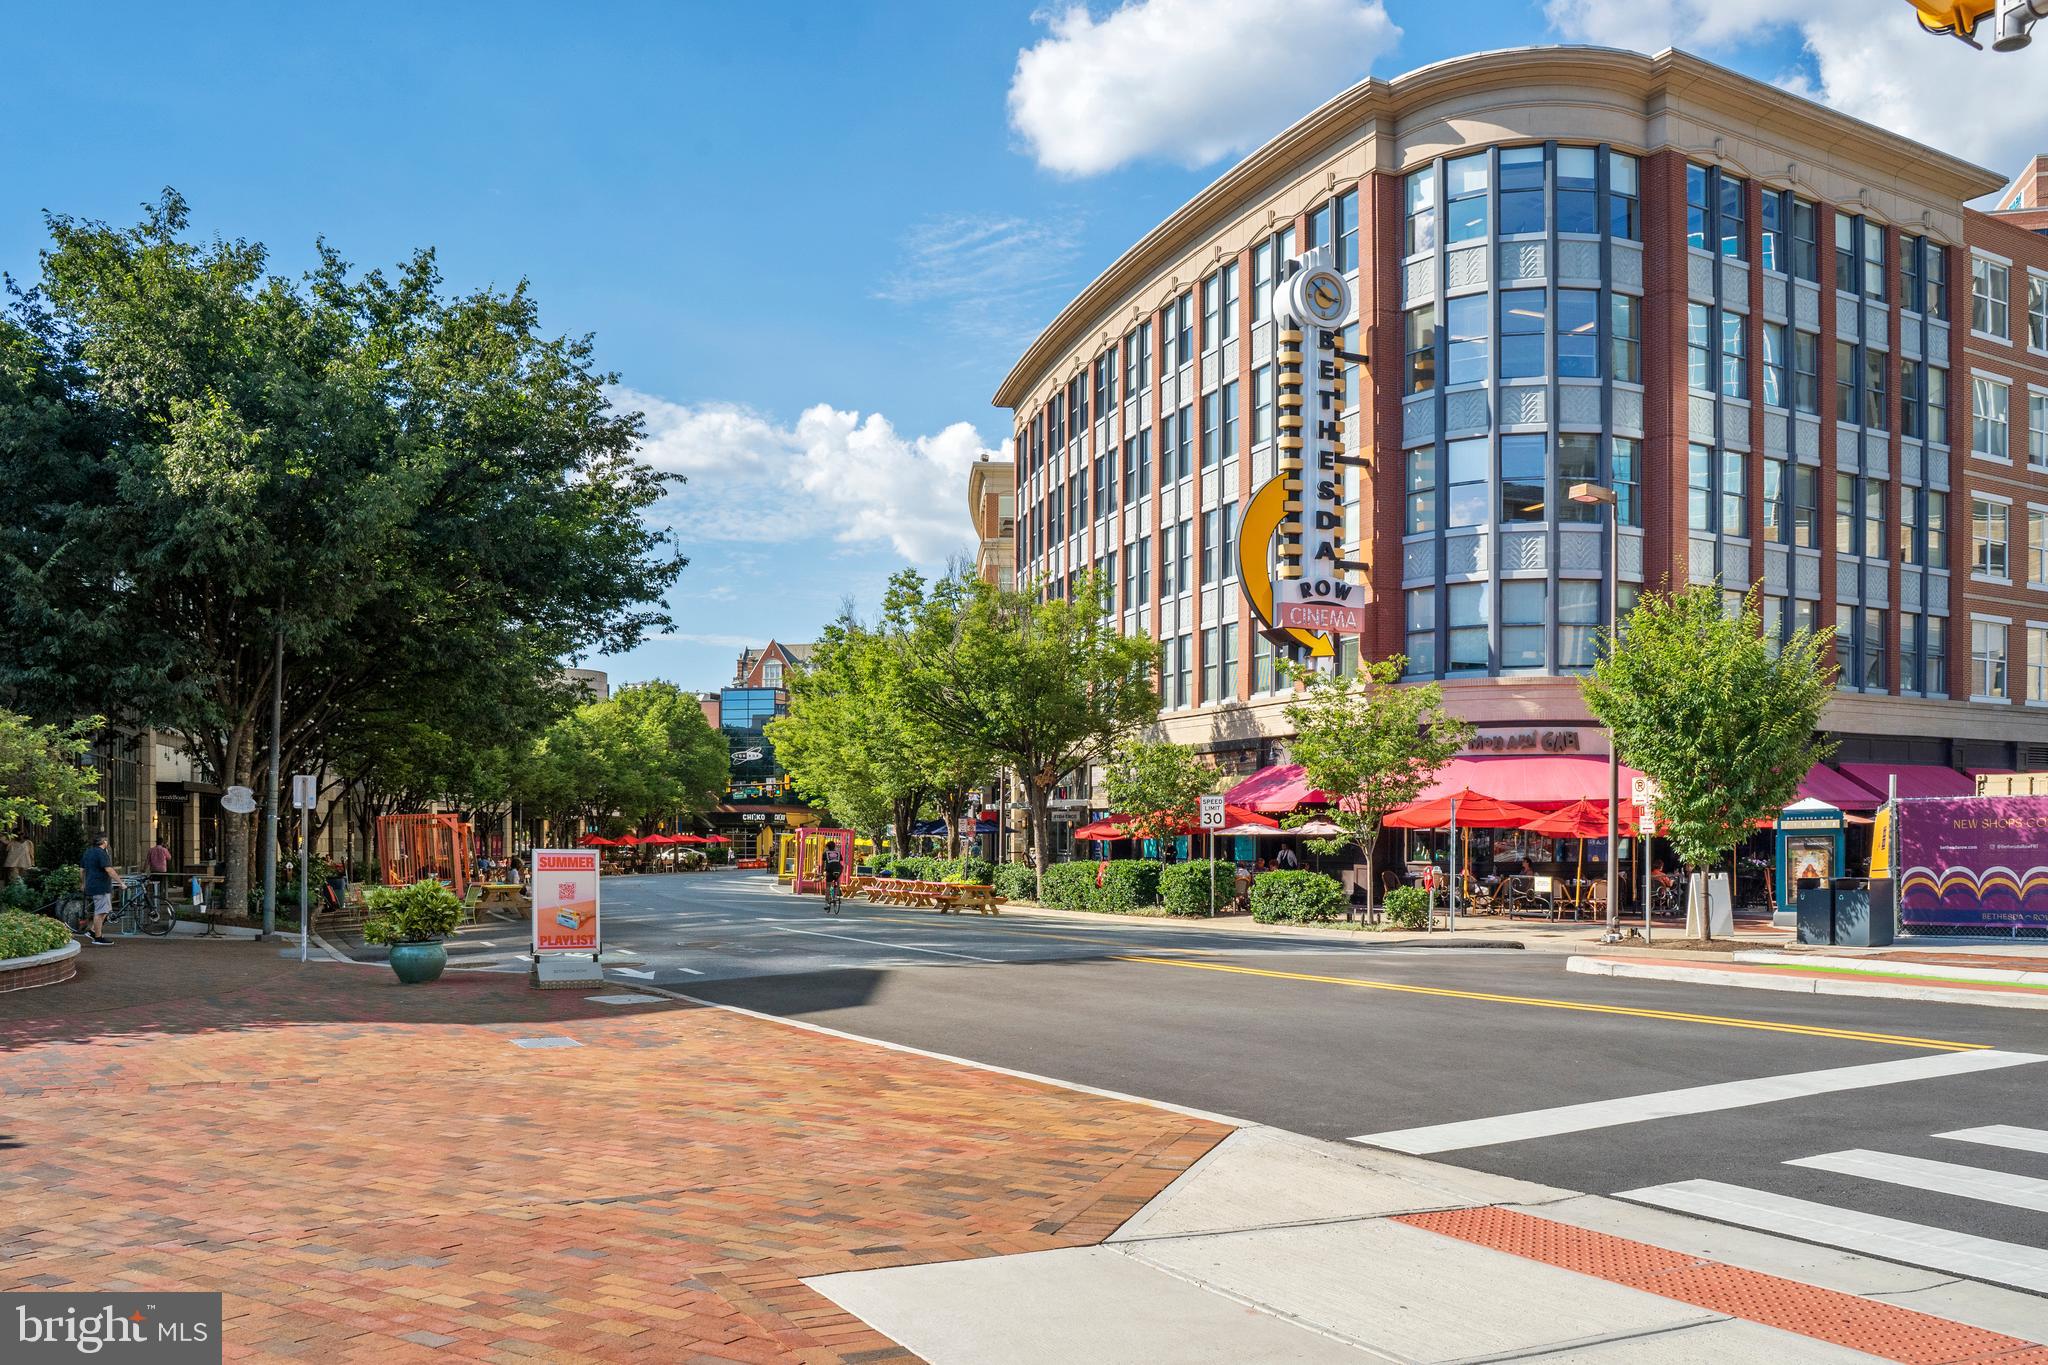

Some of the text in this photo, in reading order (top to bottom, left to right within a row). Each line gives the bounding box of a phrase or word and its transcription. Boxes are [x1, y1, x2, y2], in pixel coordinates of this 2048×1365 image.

[1314, 330, 1337, 561] BETHESDA
[1300, 579, 1353, 601] ROW
[1290, 607, 1357, 629] CINEMA
[1204, 813, 1222, 824] 30
[1953, 817, 2048, 829] NEW SHOPS CO
[540, 856, 594, 868] SUMMER
[1982, 912, 2024, 920] BETHESDA
[540, 935, 595, 946] PLAYLIST
